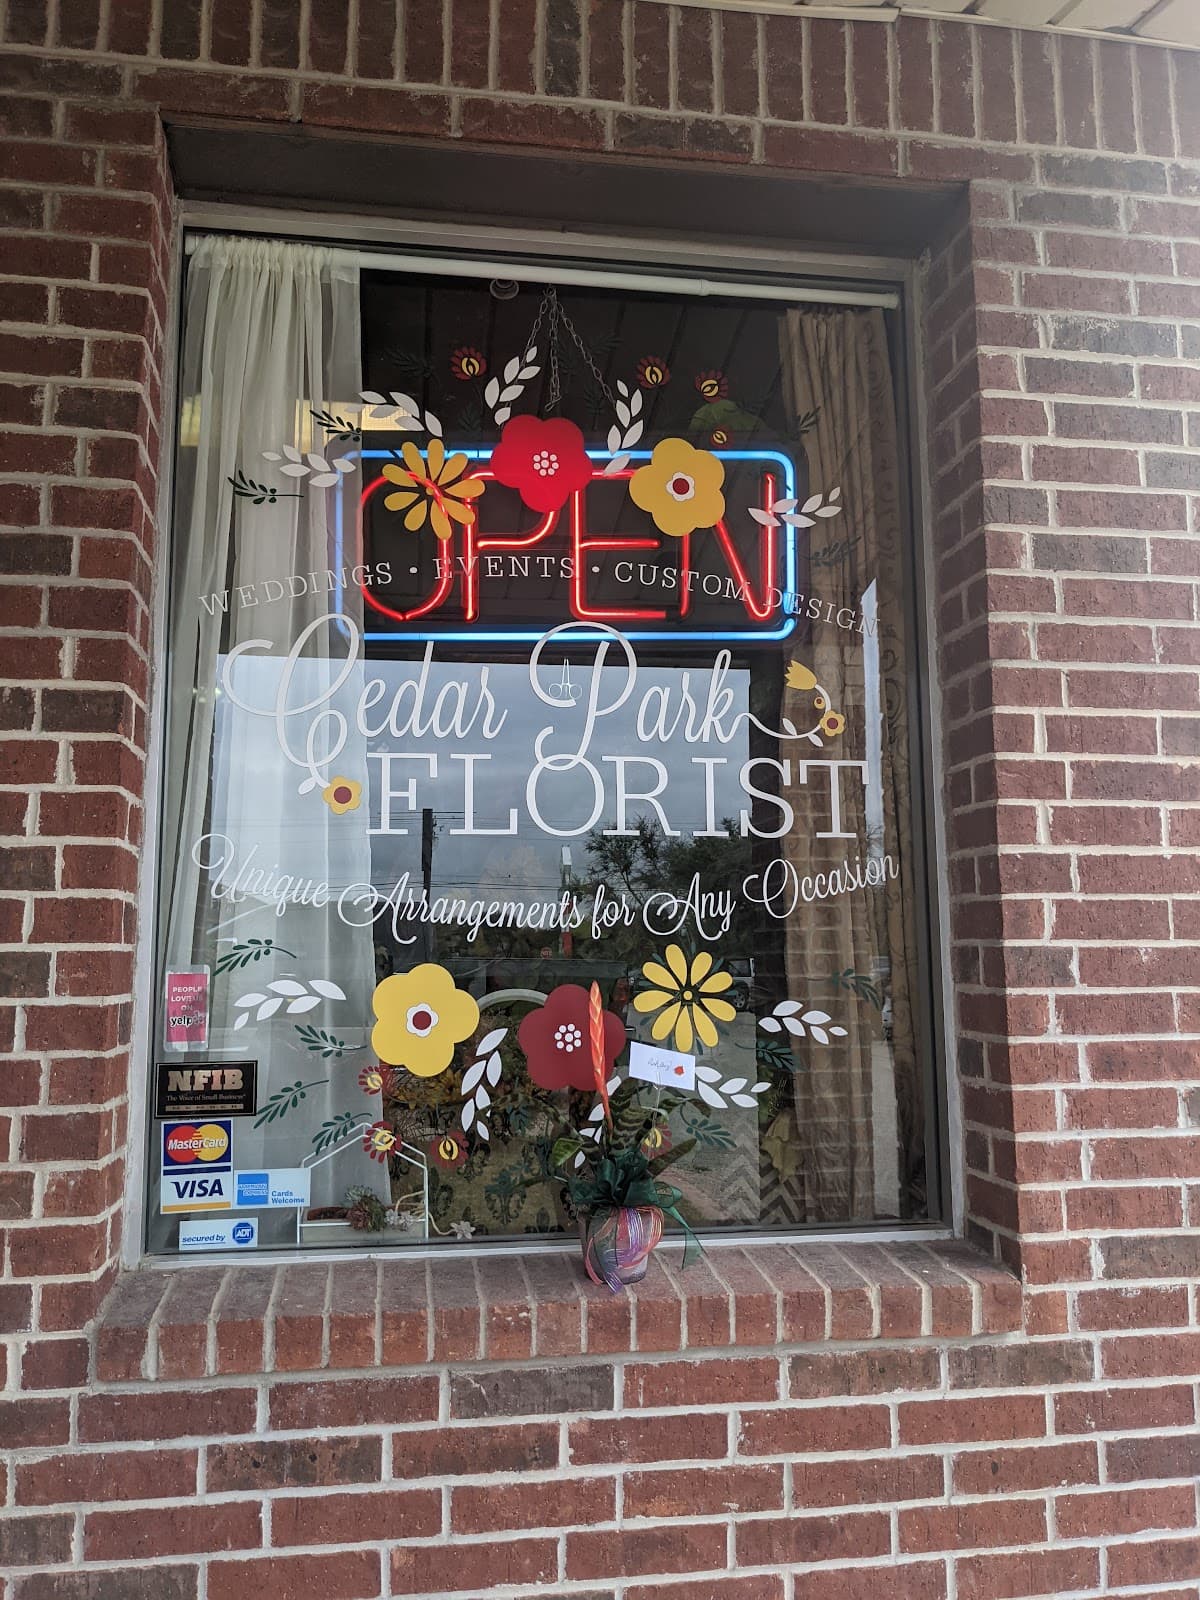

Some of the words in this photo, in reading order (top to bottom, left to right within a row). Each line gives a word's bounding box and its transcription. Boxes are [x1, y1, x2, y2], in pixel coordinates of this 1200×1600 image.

[359, 468, 778, 622] OPEN
[199, 562, 394, 616] WEDDINGS
[432, 555, 576, 580] EVENTS
[614, 561, 752, 602] CUSTOM
[763, 587, 881, 638] DESIGN
[222, 613, 508, 768] Cedar
[529, 620, 742, 771] Park
[366, 751, 871, 839] FLORIST
[191, 833, 333, 917] Unique
[337, 871, 585, 944] Arrangements
[591, 884, 636, 940] for
[642, 872, 736, 941] Any
[743, 853, 900, 919] Occasion
[170, 1015, 194, 1028] yelp
[167, 1068, 243, 1092] NFIB
[167, 1137, 226, 1150] MasterCard
[170, 1179, 223, 1199] VISA
[182, 1235, 215, 1243] secured
[216, 1234, 226, 1242] by
[236, 1229, 252, 1239] ADT
